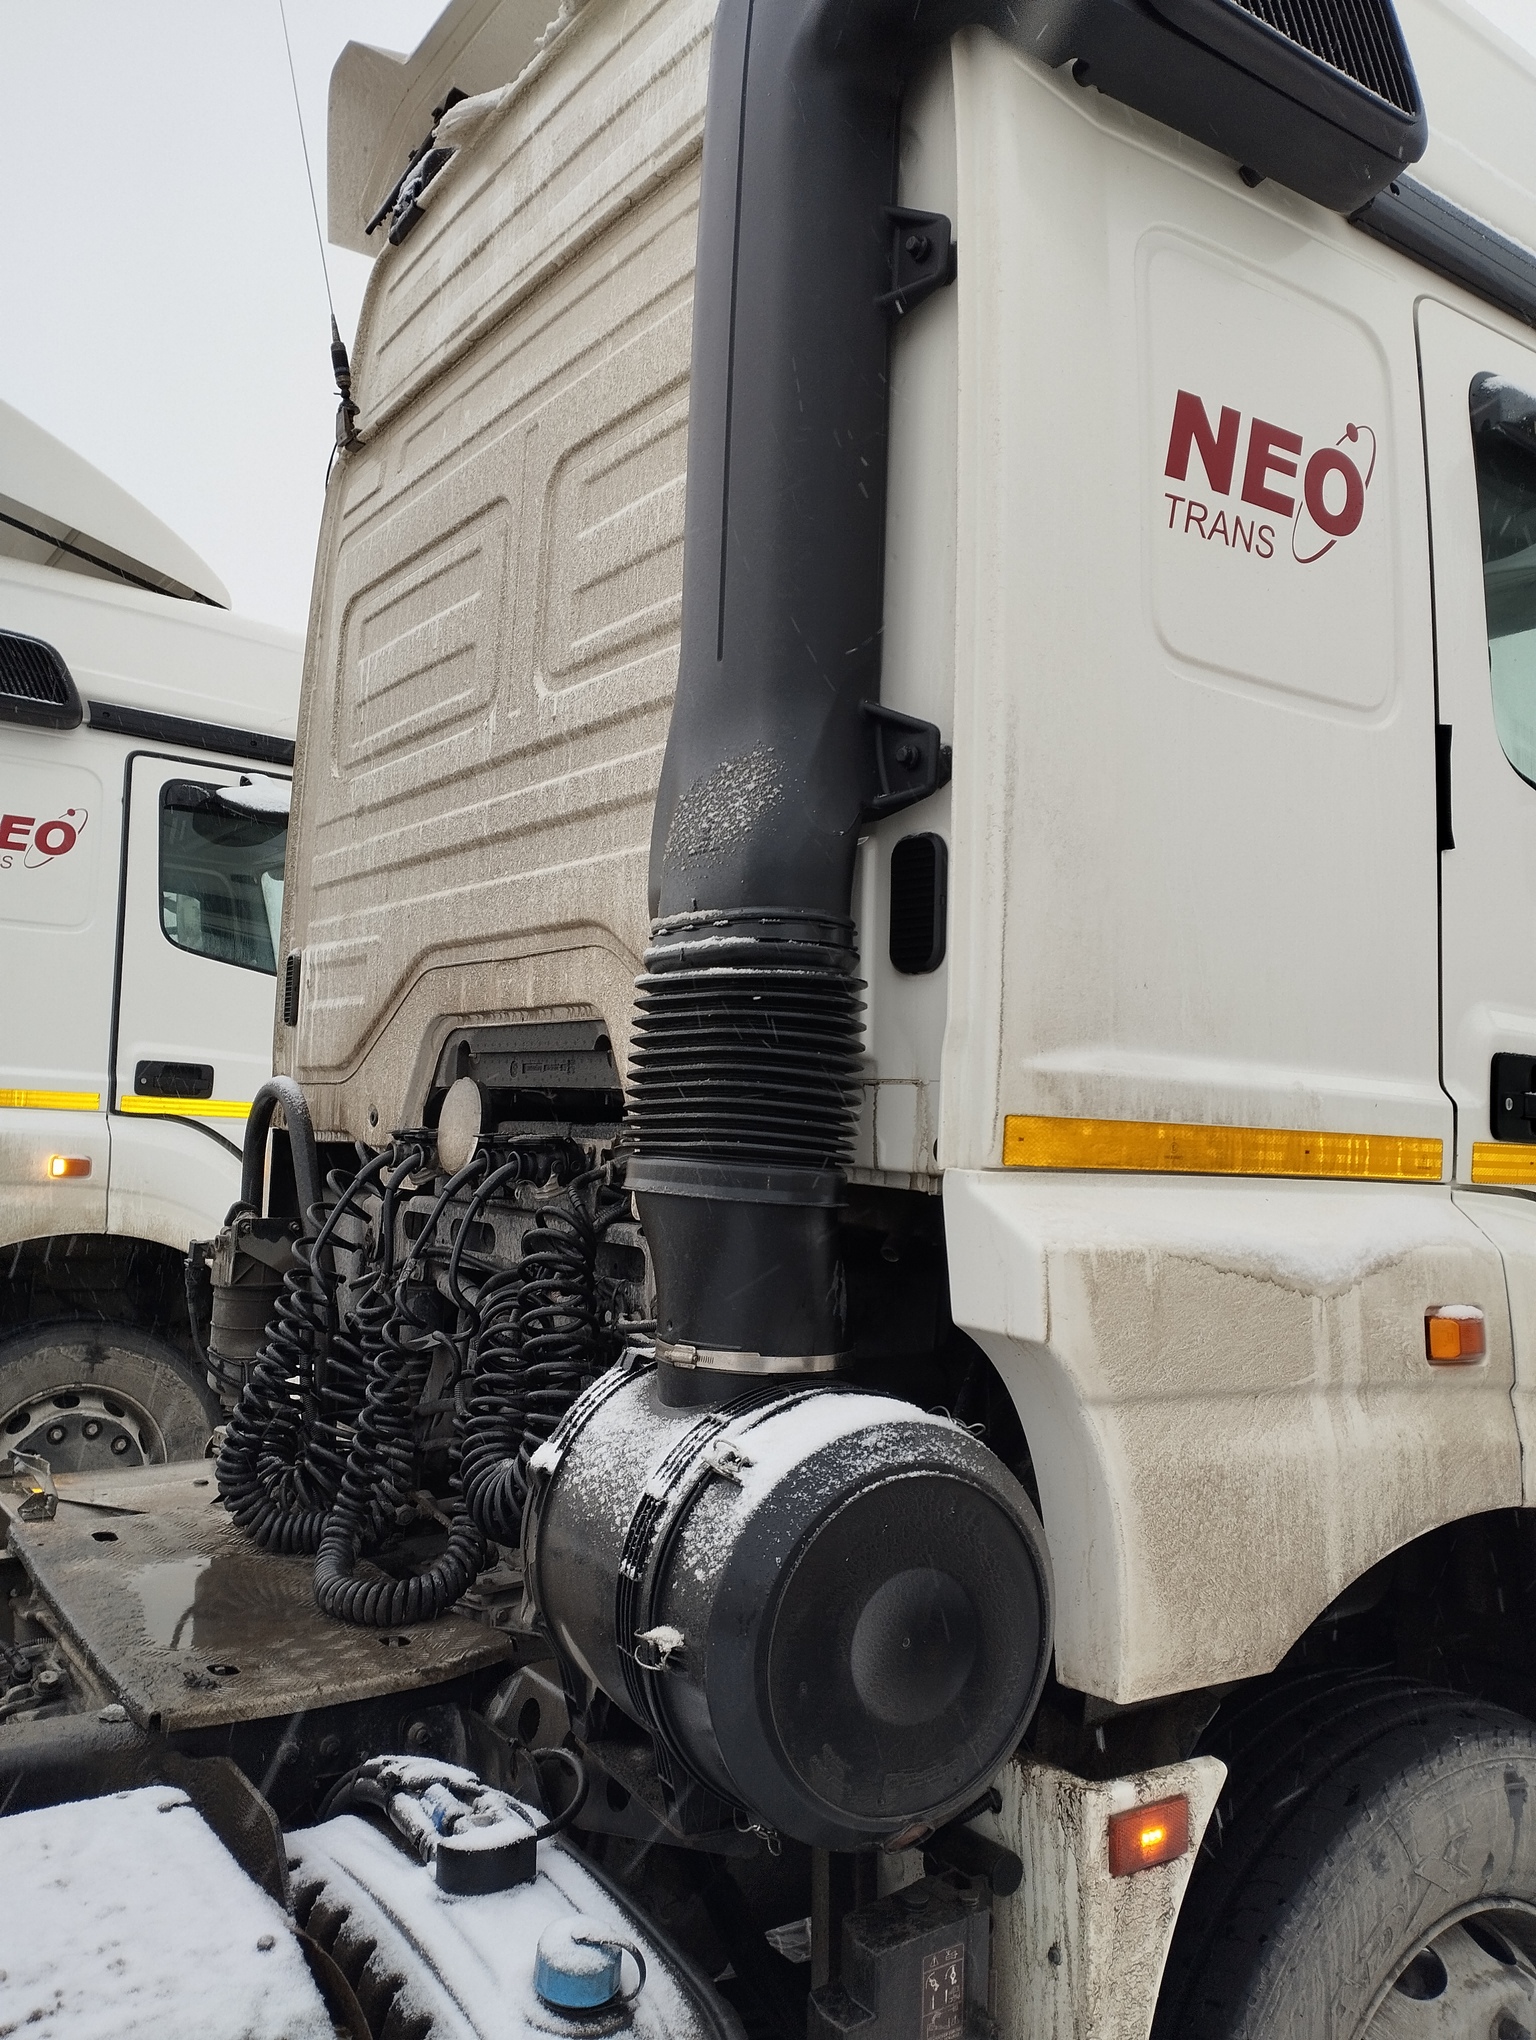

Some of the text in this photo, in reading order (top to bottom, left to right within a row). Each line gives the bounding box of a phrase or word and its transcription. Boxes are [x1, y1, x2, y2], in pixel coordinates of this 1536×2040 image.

[1164, 388, 1365, 537] NEO
[1164, 492, 1276, 559] TRANS
[0, 814, 77, 856] EO
